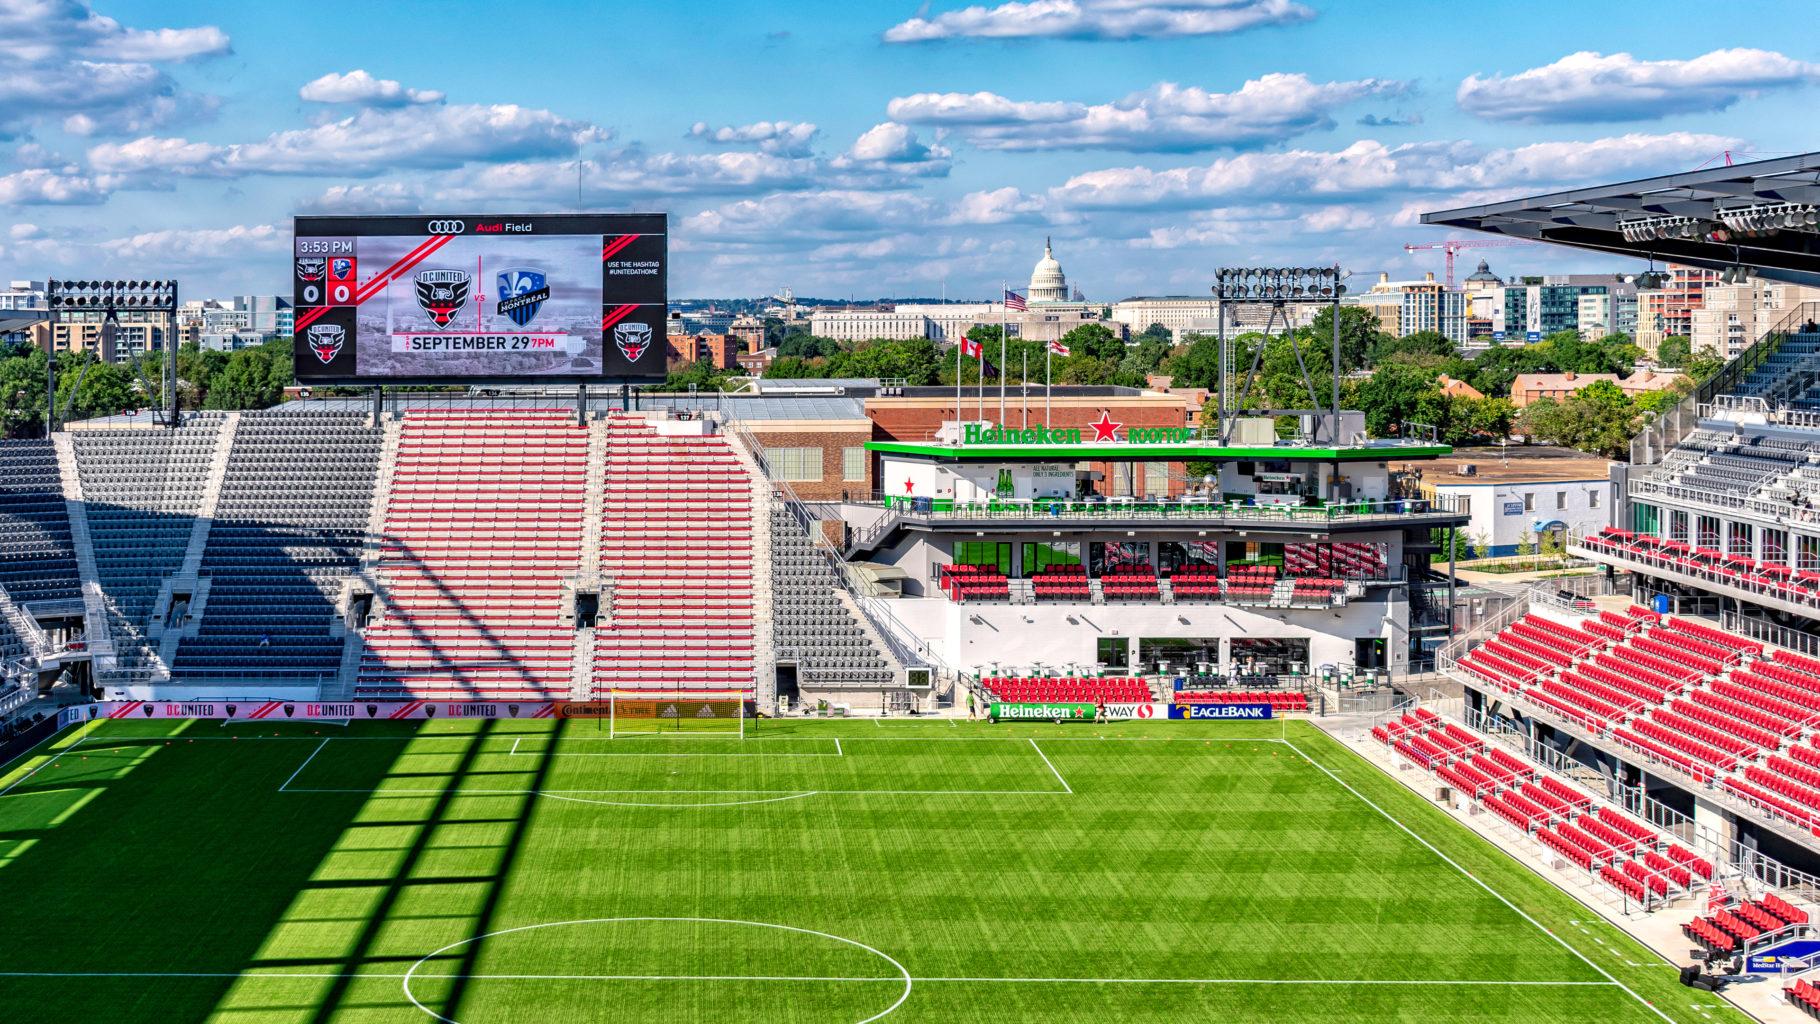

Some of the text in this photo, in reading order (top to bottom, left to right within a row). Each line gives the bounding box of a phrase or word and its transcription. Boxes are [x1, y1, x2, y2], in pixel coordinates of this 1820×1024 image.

[475, 223, 532, 232] Audi Field
[300, 241, 353, 253] 3:53 PM
[303, 285, 319, 303] 0
[334, 285, 350, 303] 0
[412, 336, 555, 350] SEPTEMBER 29 7PM
[963, 422, 1191, 445] Heineken ROOFTOP
[999, 704, 1071, 718] Heineken
